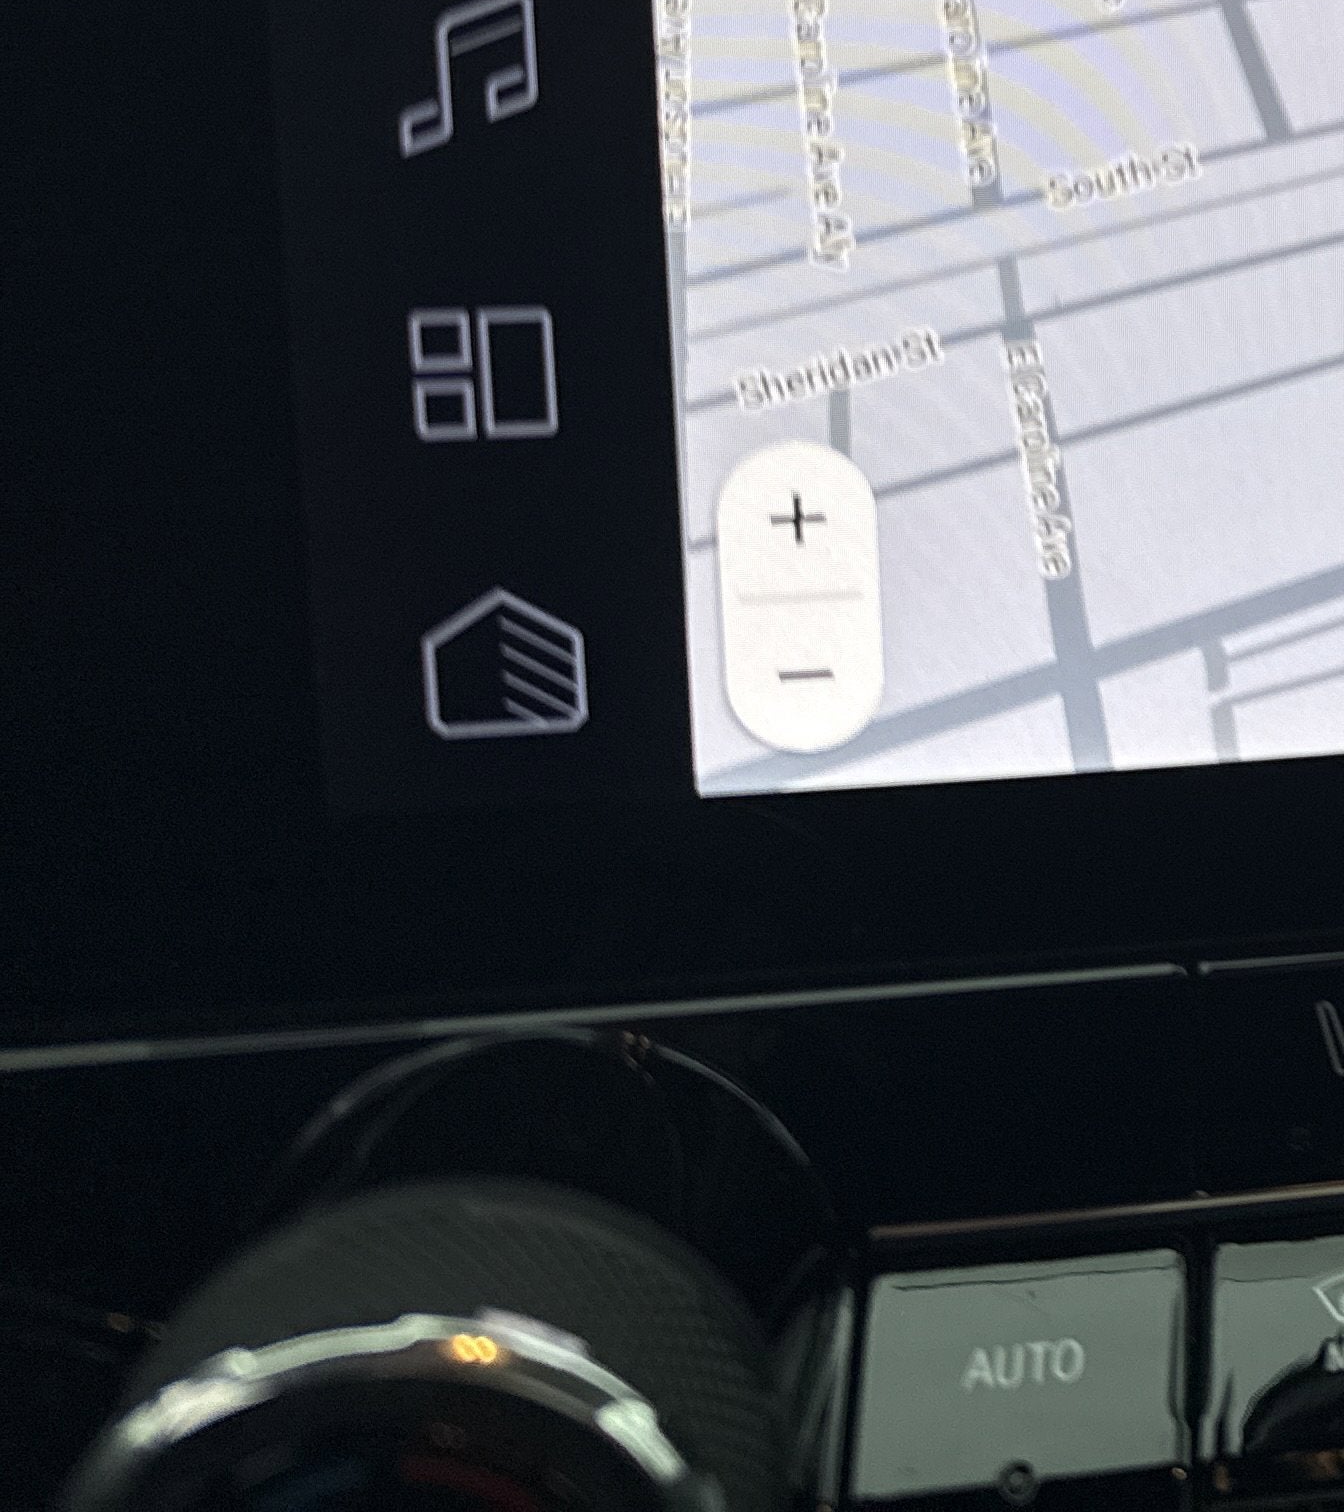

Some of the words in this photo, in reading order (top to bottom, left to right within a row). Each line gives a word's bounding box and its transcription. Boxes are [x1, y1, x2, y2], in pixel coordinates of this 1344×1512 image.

[1047, 158, 1152, 207] South
[1158, 145, 1199, 184] St
[738, 344, 898, 409] Sheridan
[901, 330, 943, 369] St
[962, 1337, 1086, 1393] AUTO
